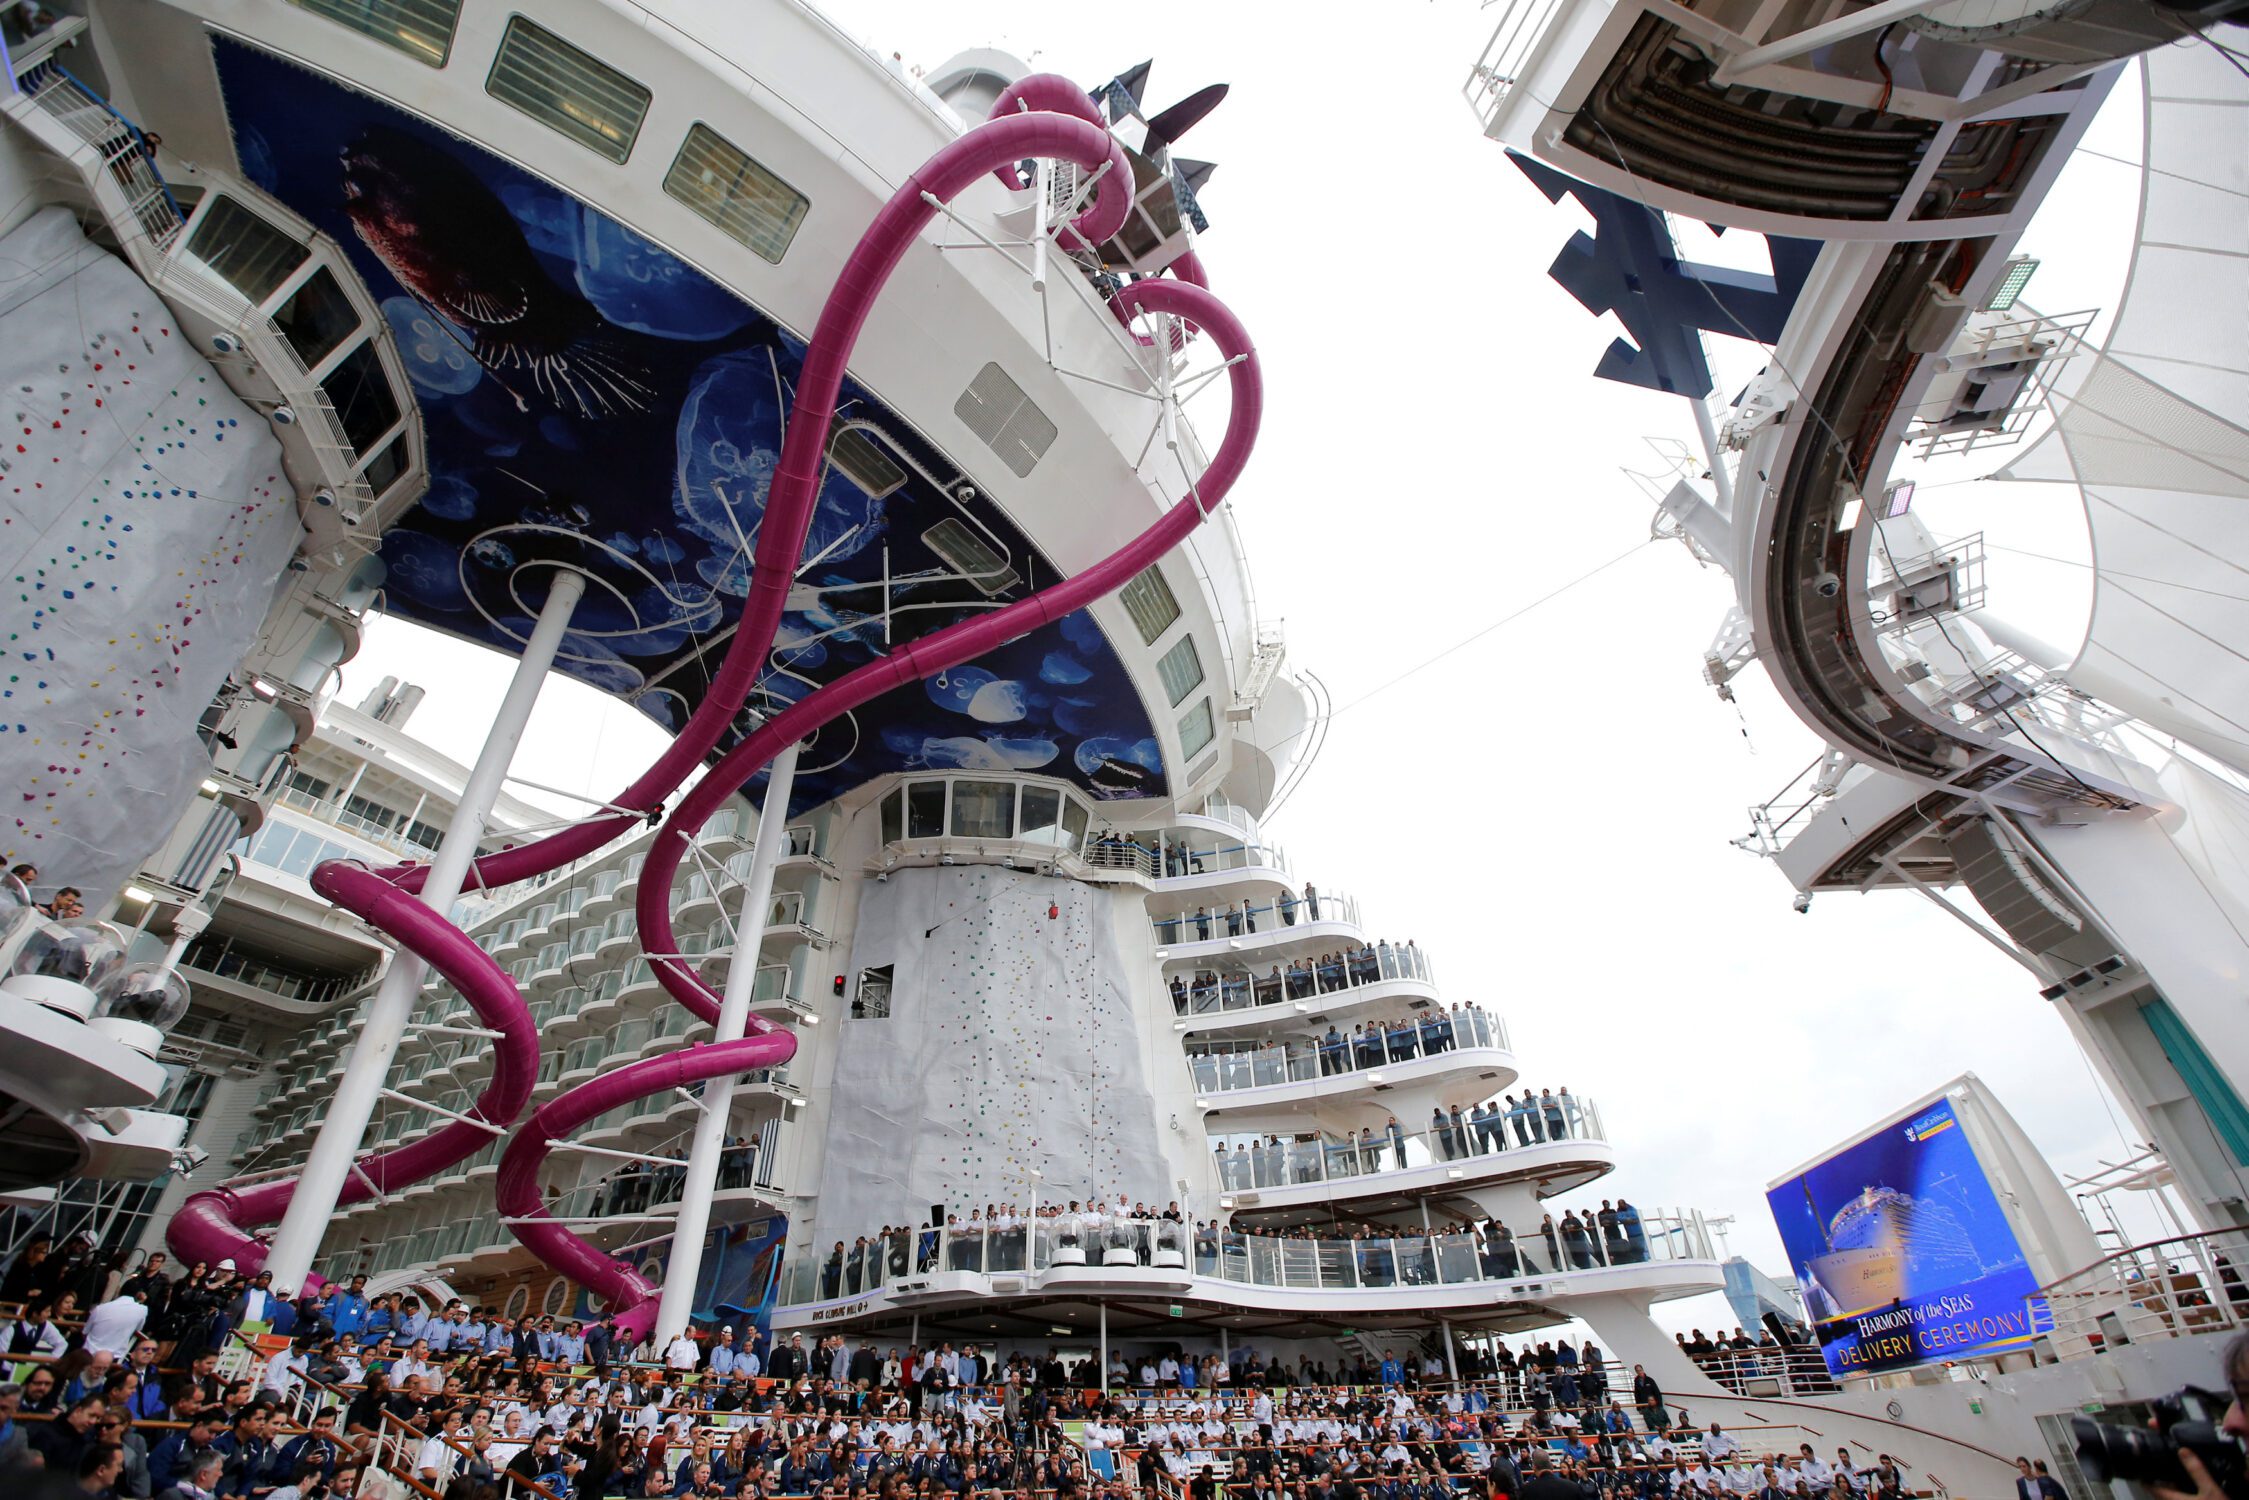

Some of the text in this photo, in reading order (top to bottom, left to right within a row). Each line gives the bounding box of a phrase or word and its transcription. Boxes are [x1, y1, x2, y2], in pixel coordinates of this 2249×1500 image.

[1839, 1310, 2026, 1366] DELIVERY CEREMONY
[1856, 1293, 1974, 1338] HARMONY of the SEAS
